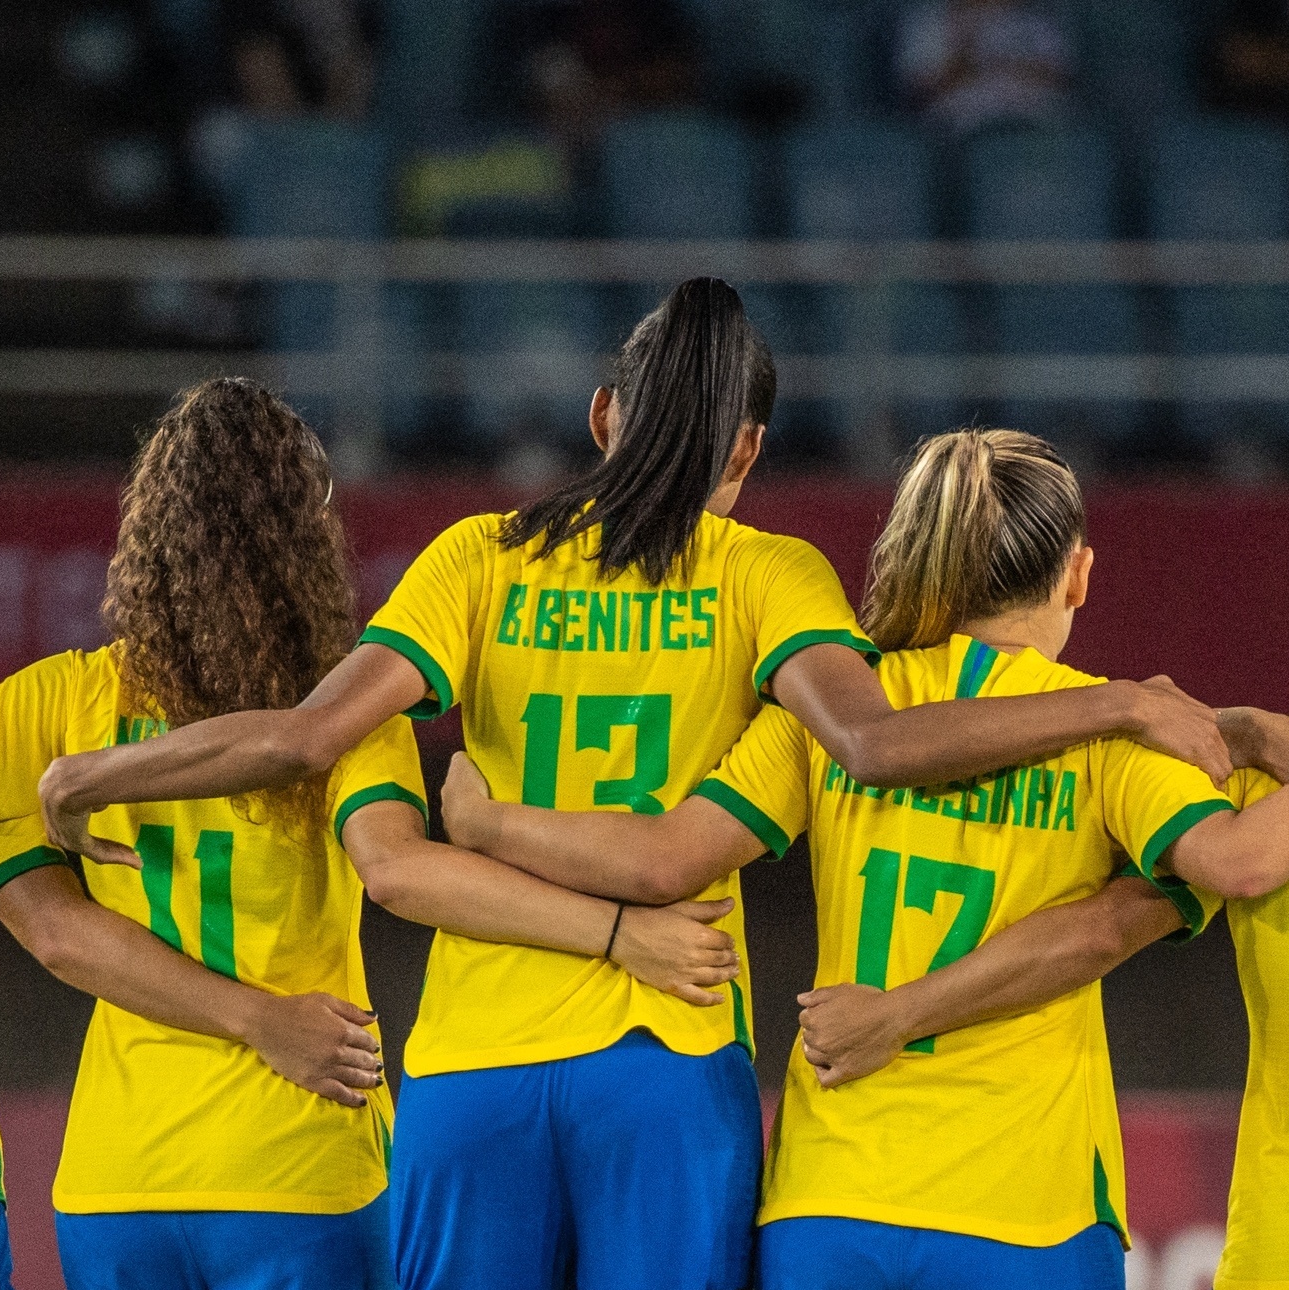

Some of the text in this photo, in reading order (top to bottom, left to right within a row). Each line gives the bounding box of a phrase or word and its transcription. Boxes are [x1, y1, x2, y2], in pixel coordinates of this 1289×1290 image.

[497, 583, 718, 652] B.BENITES
[520, 693, 673, 816] 13
[134, 823, 241, 982] 11
[855, 847, 996, 1054] 17
